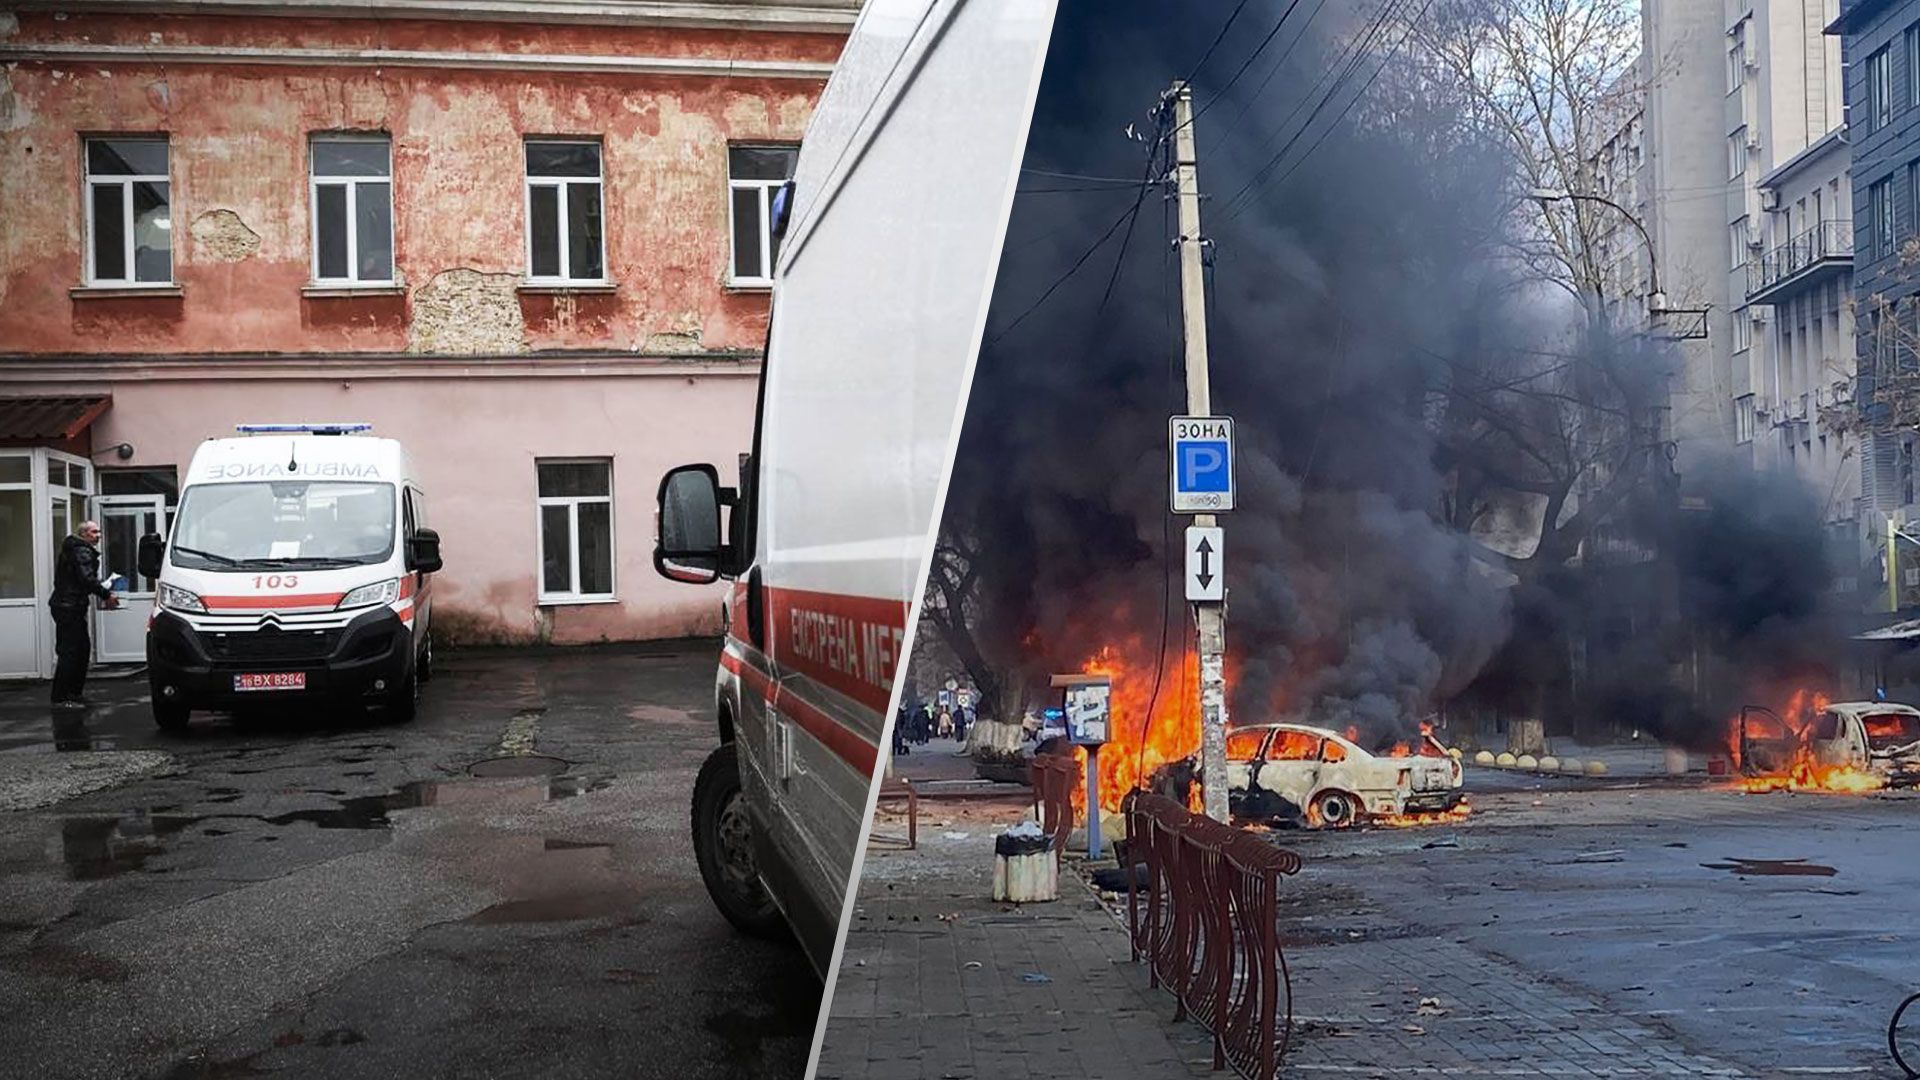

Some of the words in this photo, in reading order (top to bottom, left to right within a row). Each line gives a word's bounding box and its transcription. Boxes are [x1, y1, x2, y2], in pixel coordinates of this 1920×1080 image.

[1178, 424, 1227, 439] ЗОНА
[1185, 447, 1222, 490] P
[252, 574, 299, 589] 103
[790, 608, 861, 679] ЕКСТРЕНА
